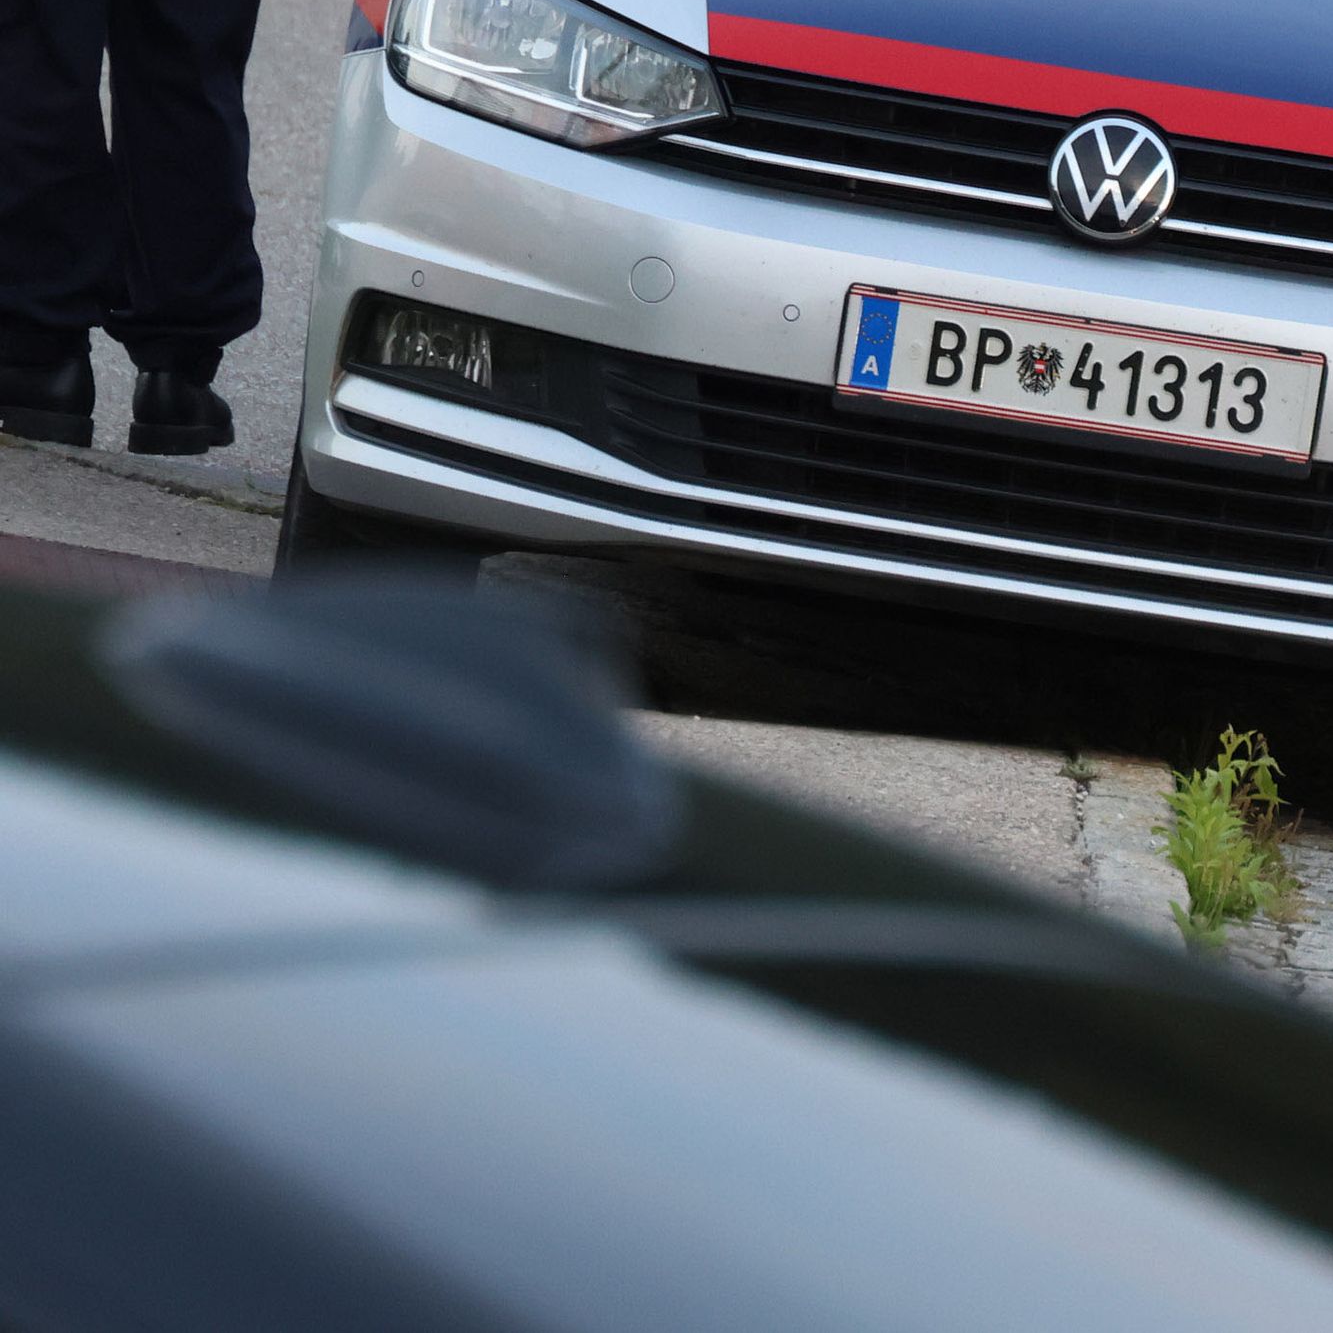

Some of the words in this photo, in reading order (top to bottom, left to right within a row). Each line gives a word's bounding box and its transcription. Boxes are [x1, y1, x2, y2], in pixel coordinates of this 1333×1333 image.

[860, 354, 880, 377] A
[925, 319, 1013, 392] BP
[1069, 341, 1269, 434] 41313
